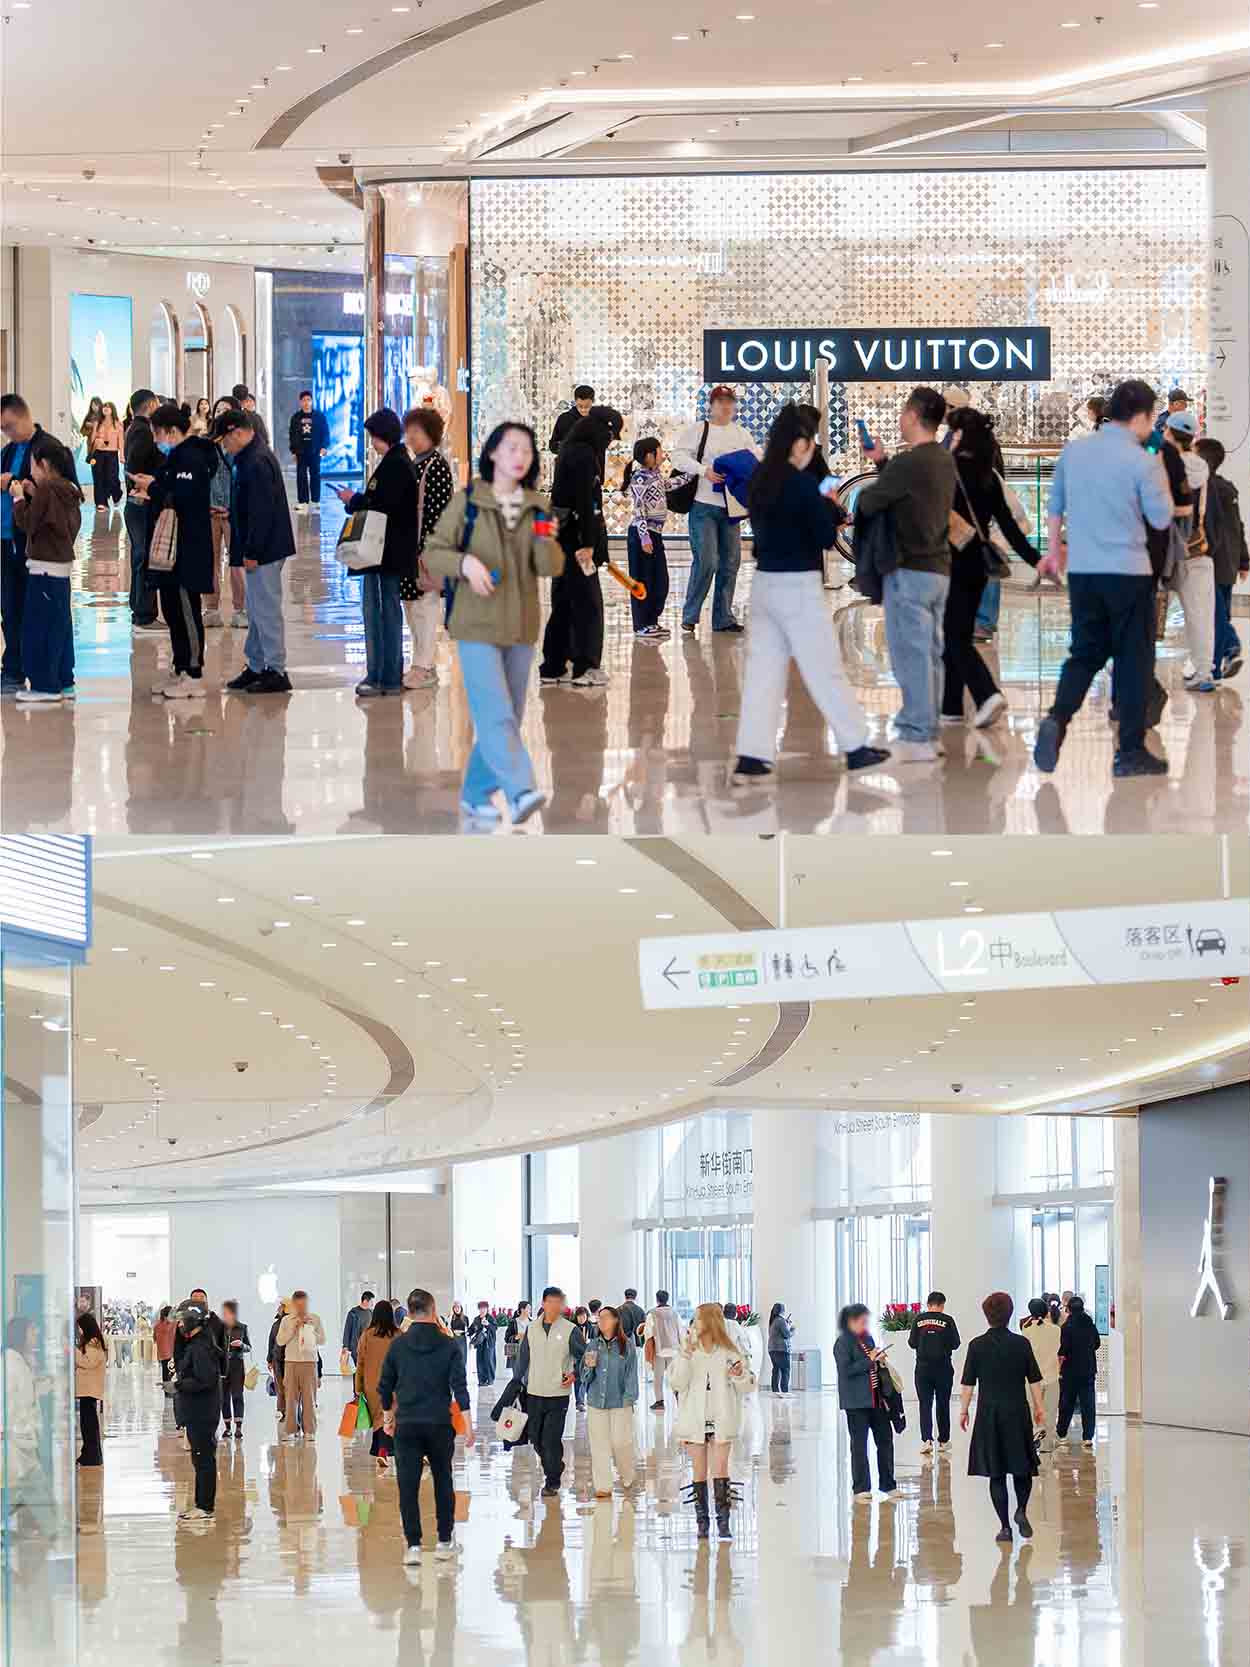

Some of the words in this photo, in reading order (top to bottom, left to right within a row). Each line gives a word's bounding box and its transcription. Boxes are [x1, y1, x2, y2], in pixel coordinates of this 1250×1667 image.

[720, 339, 837, 372] LOUIS
[854, 338, 1034, 372] VUITTON
[1126, 924, 1184, 947] 落客区
[937, 928, 989, 977] L2
[700, 1149, 753, 1178] 新华街南门
